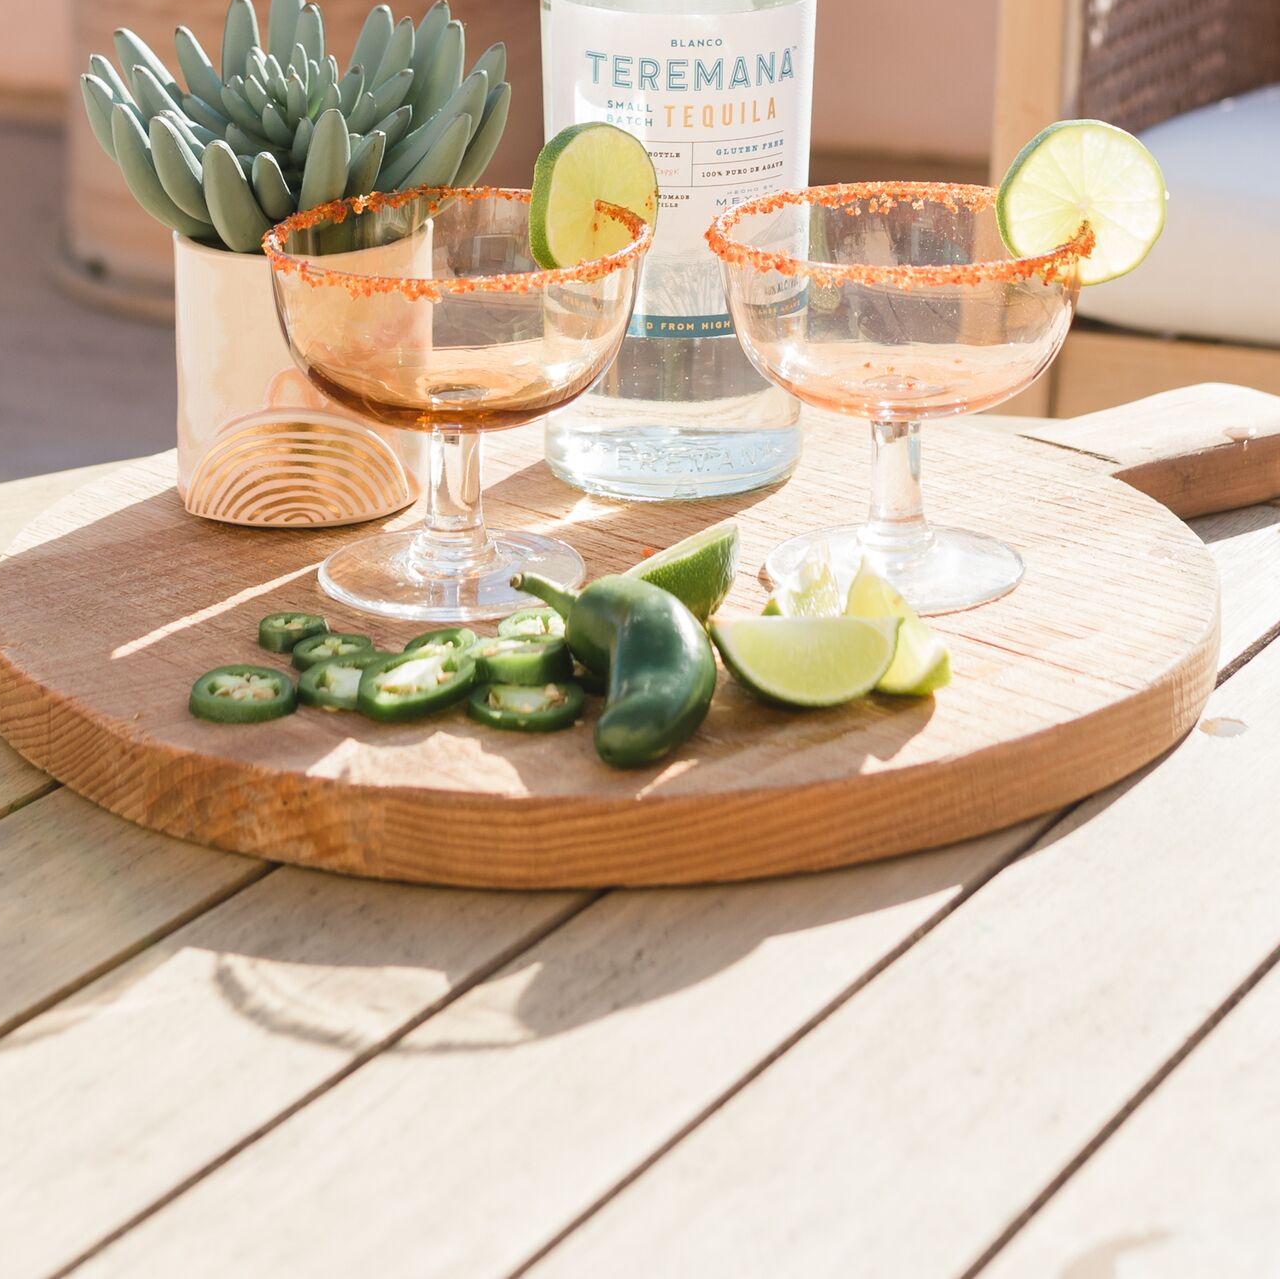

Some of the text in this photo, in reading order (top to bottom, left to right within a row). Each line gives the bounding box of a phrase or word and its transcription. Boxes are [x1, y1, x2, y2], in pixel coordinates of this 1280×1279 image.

[670, 38, 723, 48] BLANCO
[607, 99, 653, 113] SMALL
[664, 96, 776, 128] TEQUILA
[606, 114, 653, 127] BATCH
[715, 138, 784, 156] GLUTEN FREE
[725, 168, 748, 177] PURO
[750, 166, 759, 174] DE
[762, 160, 783, 171] AGAVE
[660, 321, 695, 331] FROM
